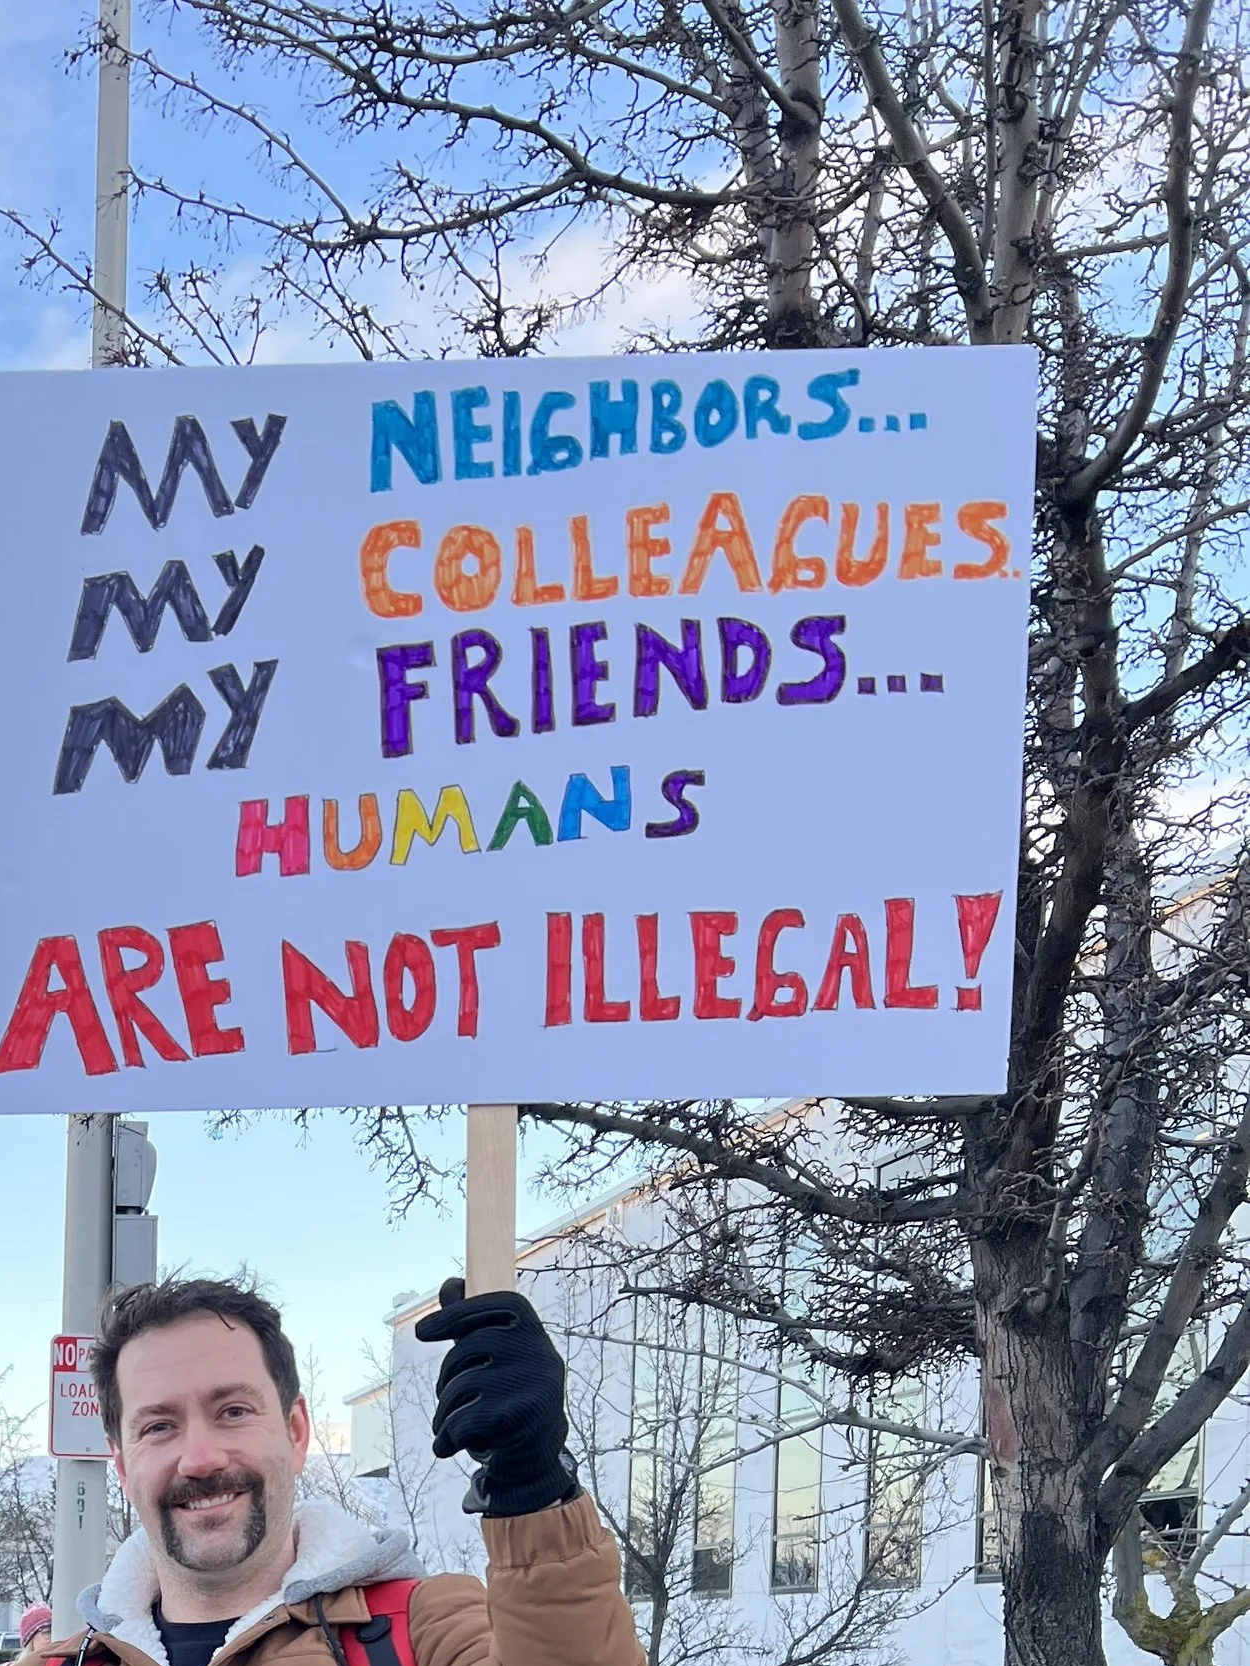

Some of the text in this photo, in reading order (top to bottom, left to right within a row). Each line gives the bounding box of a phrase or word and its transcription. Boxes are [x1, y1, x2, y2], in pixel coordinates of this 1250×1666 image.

[81, 369, 926, 536] MY NEIGHBORS...
[67, 544, 266, 662] MY
[52, 615, 944, 795] MY FRIENDS...
[236, 765, 705, 877] HUMANS
[282, 921, 501, 1055] NOT
[543, 890, 1003, 1028] ILLEGAL!
[53, 1343, 76, 1367] NO
[60, 1382, 96, 1398] LOAD
[72, 1401, 100, 1416] ZON
